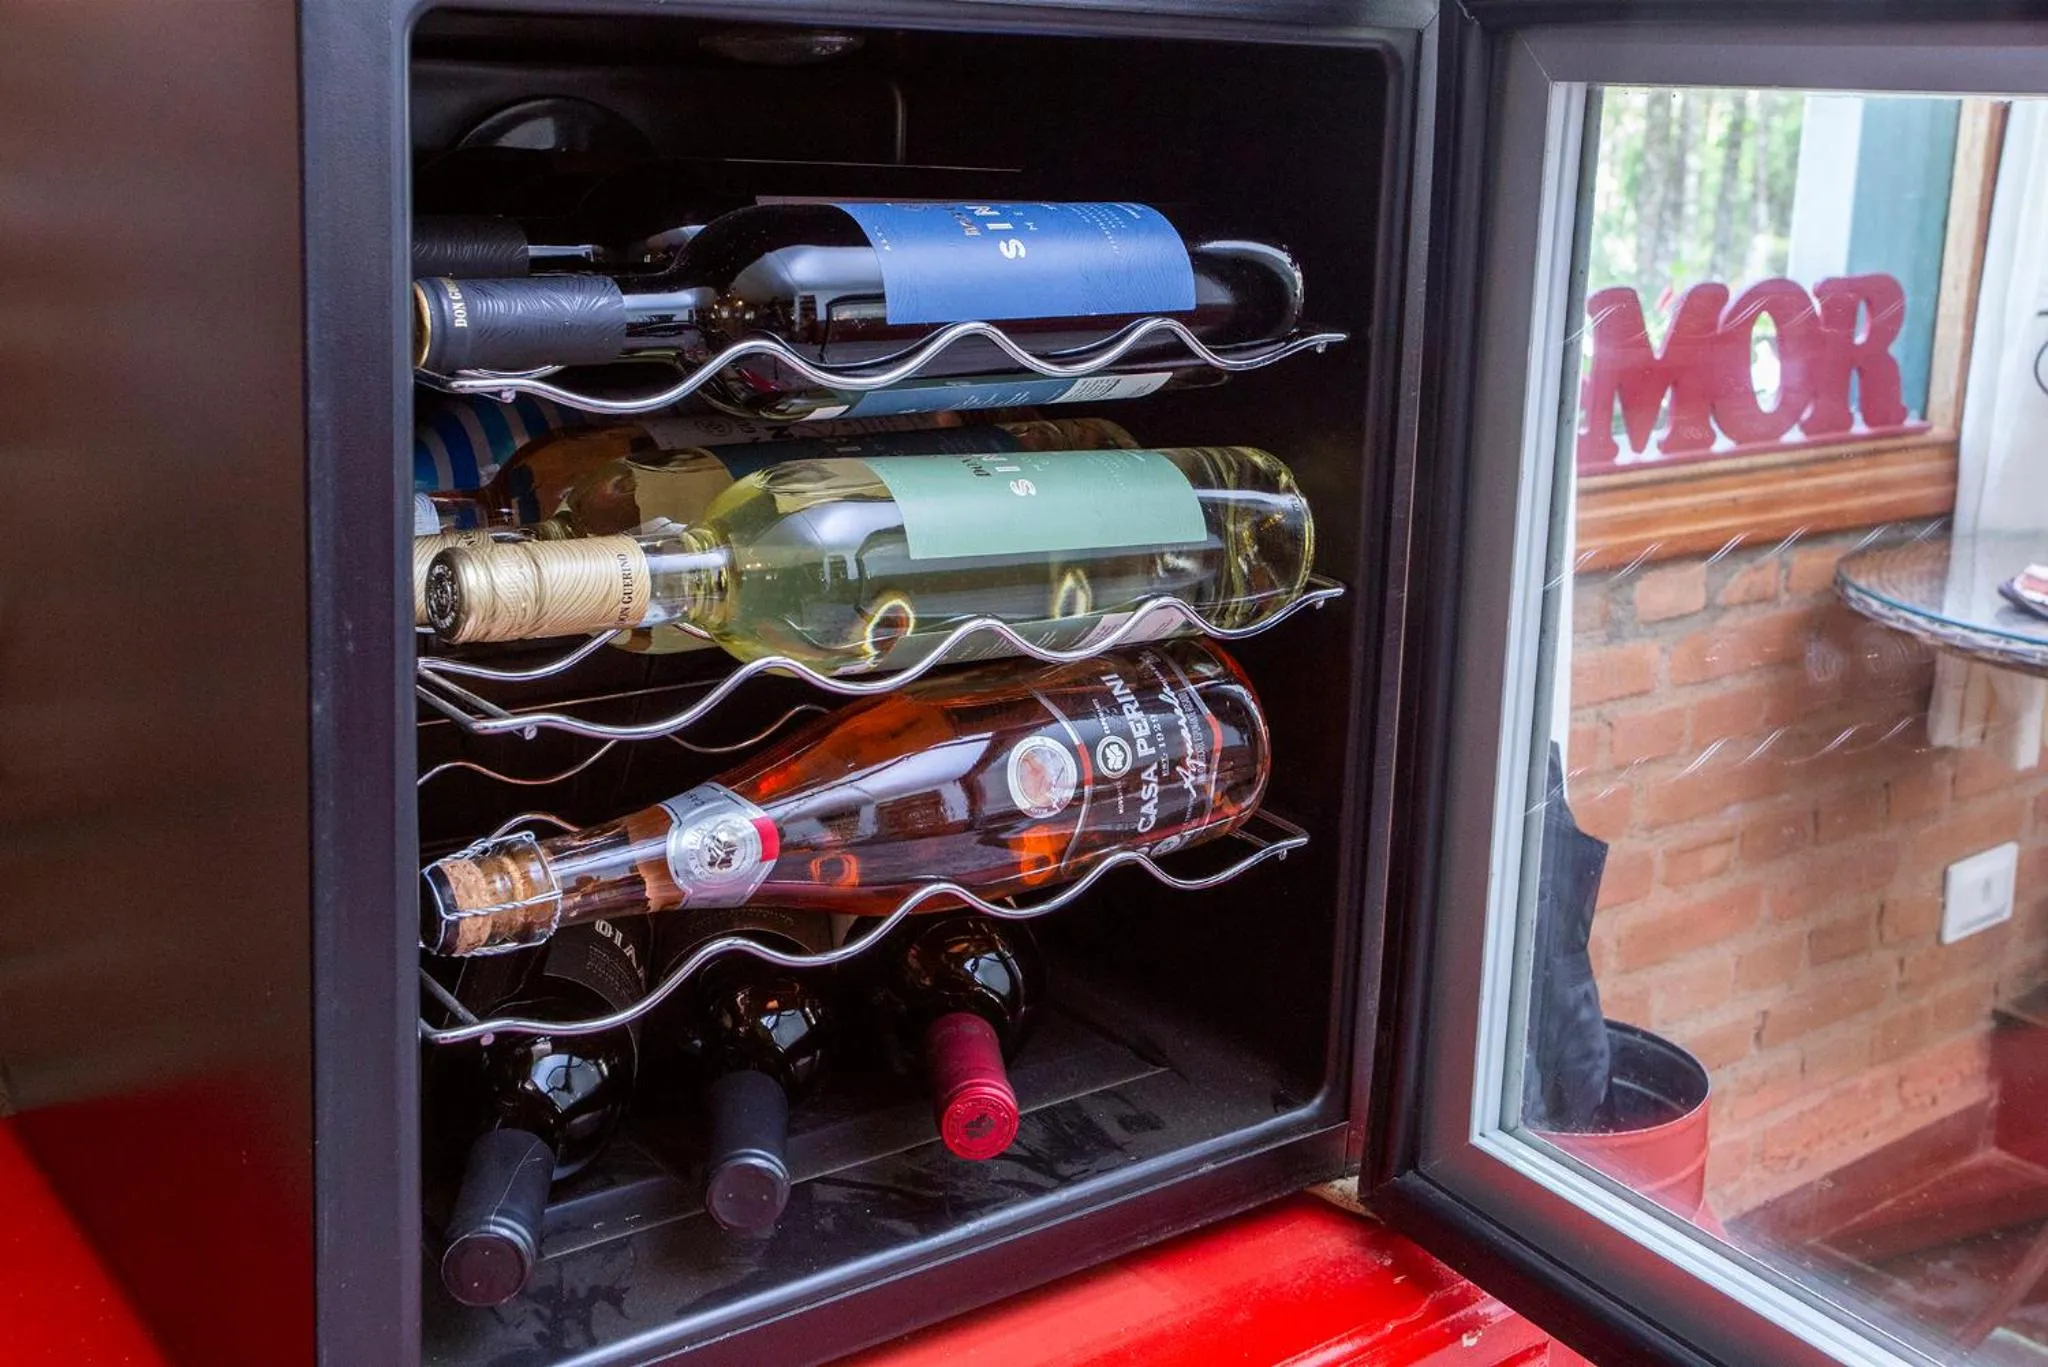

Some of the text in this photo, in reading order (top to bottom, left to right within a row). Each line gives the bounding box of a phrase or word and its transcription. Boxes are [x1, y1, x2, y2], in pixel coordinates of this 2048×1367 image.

[451, 302, 469, 329] DON
[1579, 273, 1908, 466] MOR
[616, 553, 634, 605] GUERINO
[1101, 673, 1159, 833] CASA PERINI
[1150, 713, 1167, 749] 1929
